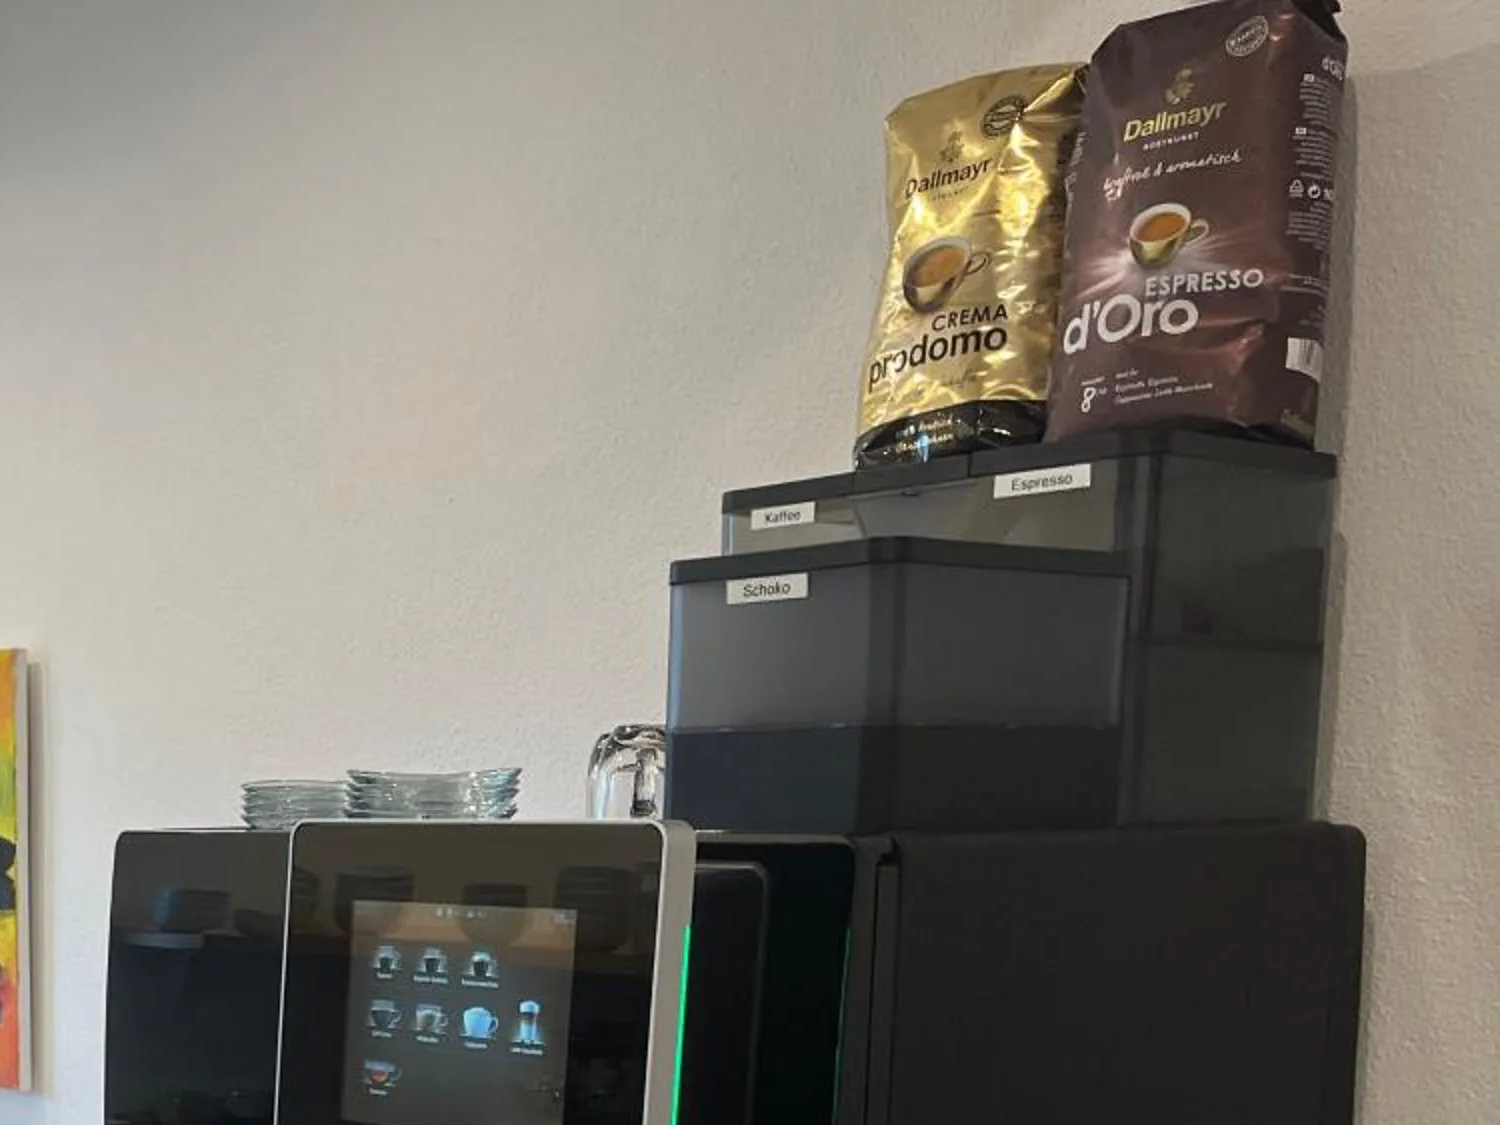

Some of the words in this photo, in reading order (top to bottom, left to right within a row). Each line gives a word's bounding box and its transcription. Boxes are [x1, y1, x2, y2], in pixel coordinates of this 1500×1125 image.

[1123, 100, 1228, 142] Dallmayr
[905, 158, 993, 199] Dallmayr
[1144, 268, 1265, 298] ESPRESSO
[931, 303, 1009, 332] CREMA
[1062, 293, 1199, 356] d'Oro
[867, 324, 1009, 393] prodomo
[1010, 472, 1074, 493] Espresso
[764, 510, 801, 524] Kaffee
[742, 580, 792, 599] Schoko
